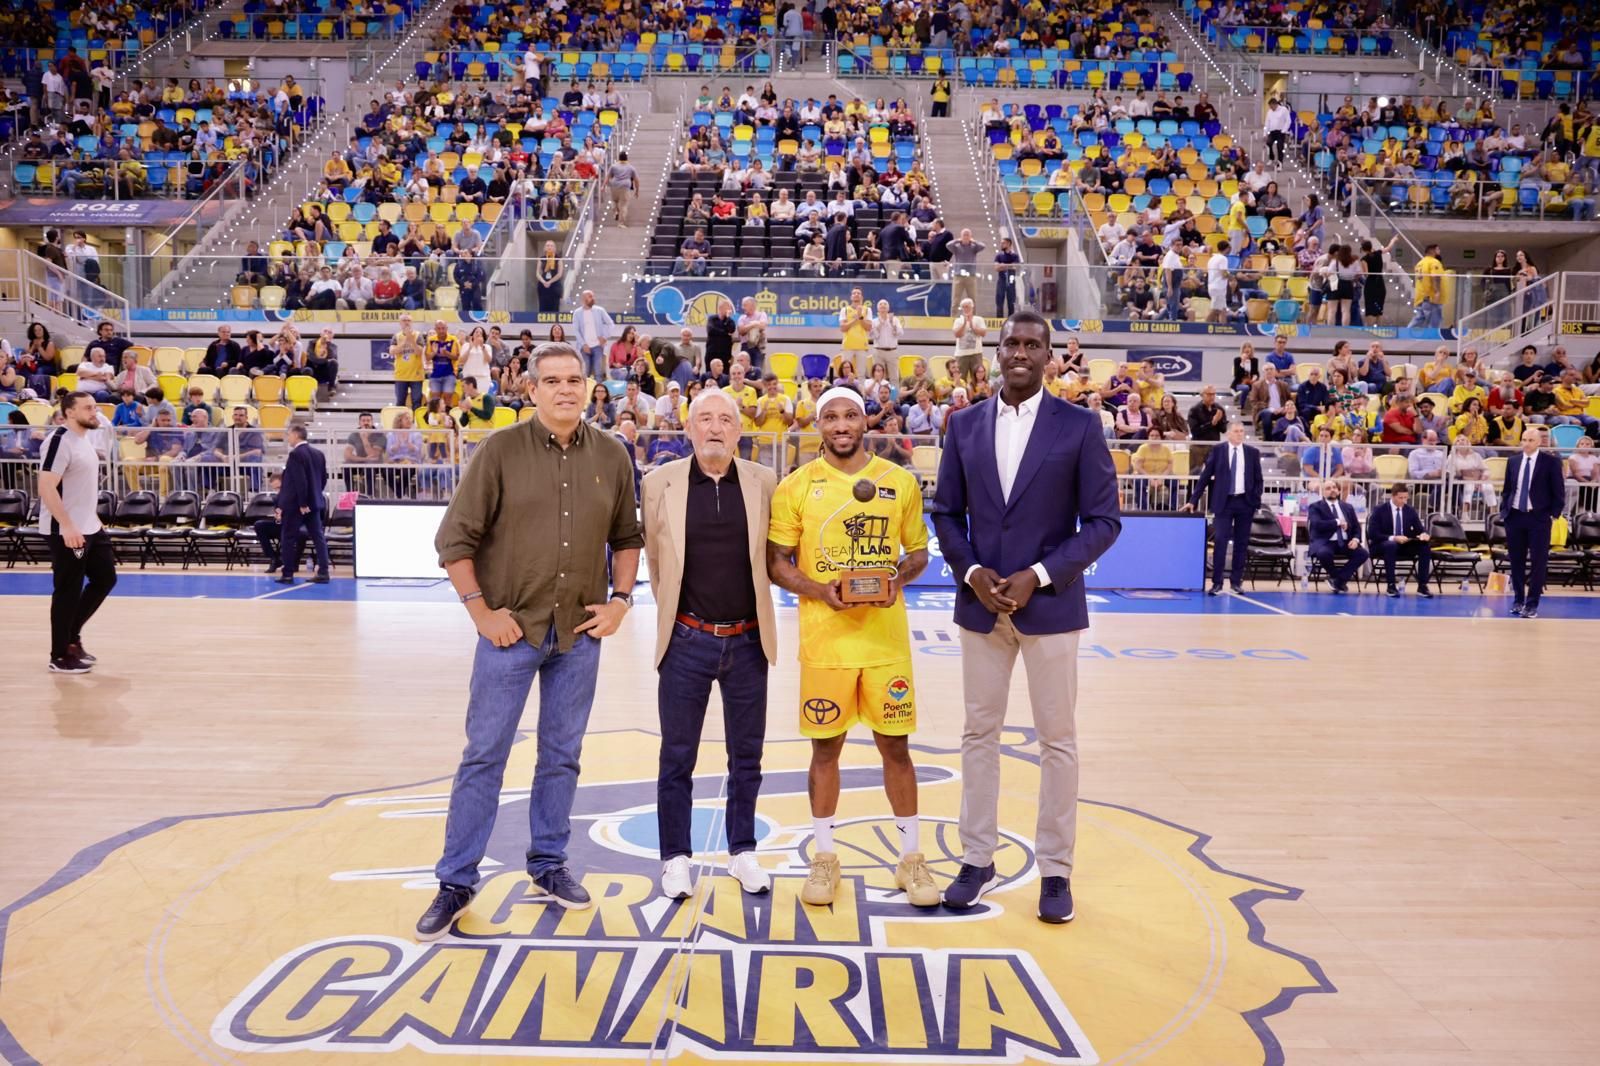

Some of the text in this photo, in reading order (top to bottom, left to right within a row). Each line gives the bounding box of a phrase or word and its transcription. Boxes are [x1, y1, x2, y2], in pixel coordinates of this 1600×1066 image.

[69, 203, 140, 212] ROES
[789, 295, 849, 310] Cabildo
[168, 311, 218, 320] GRAN CANARIA
[361, 312, 379, 321] GRAN
[537, 313, 557, 323] GRAN
[1129, 323, 1180, 333] GRAN CANARIA
[1155, 362, 1181, 370] LCA
[883, 701, 912, 712] Poema
[883, 710, 913, 719] del Mar
[454, 870, 869, 944] GRAN
[232, 941, 1076, 1058] CANARIA
